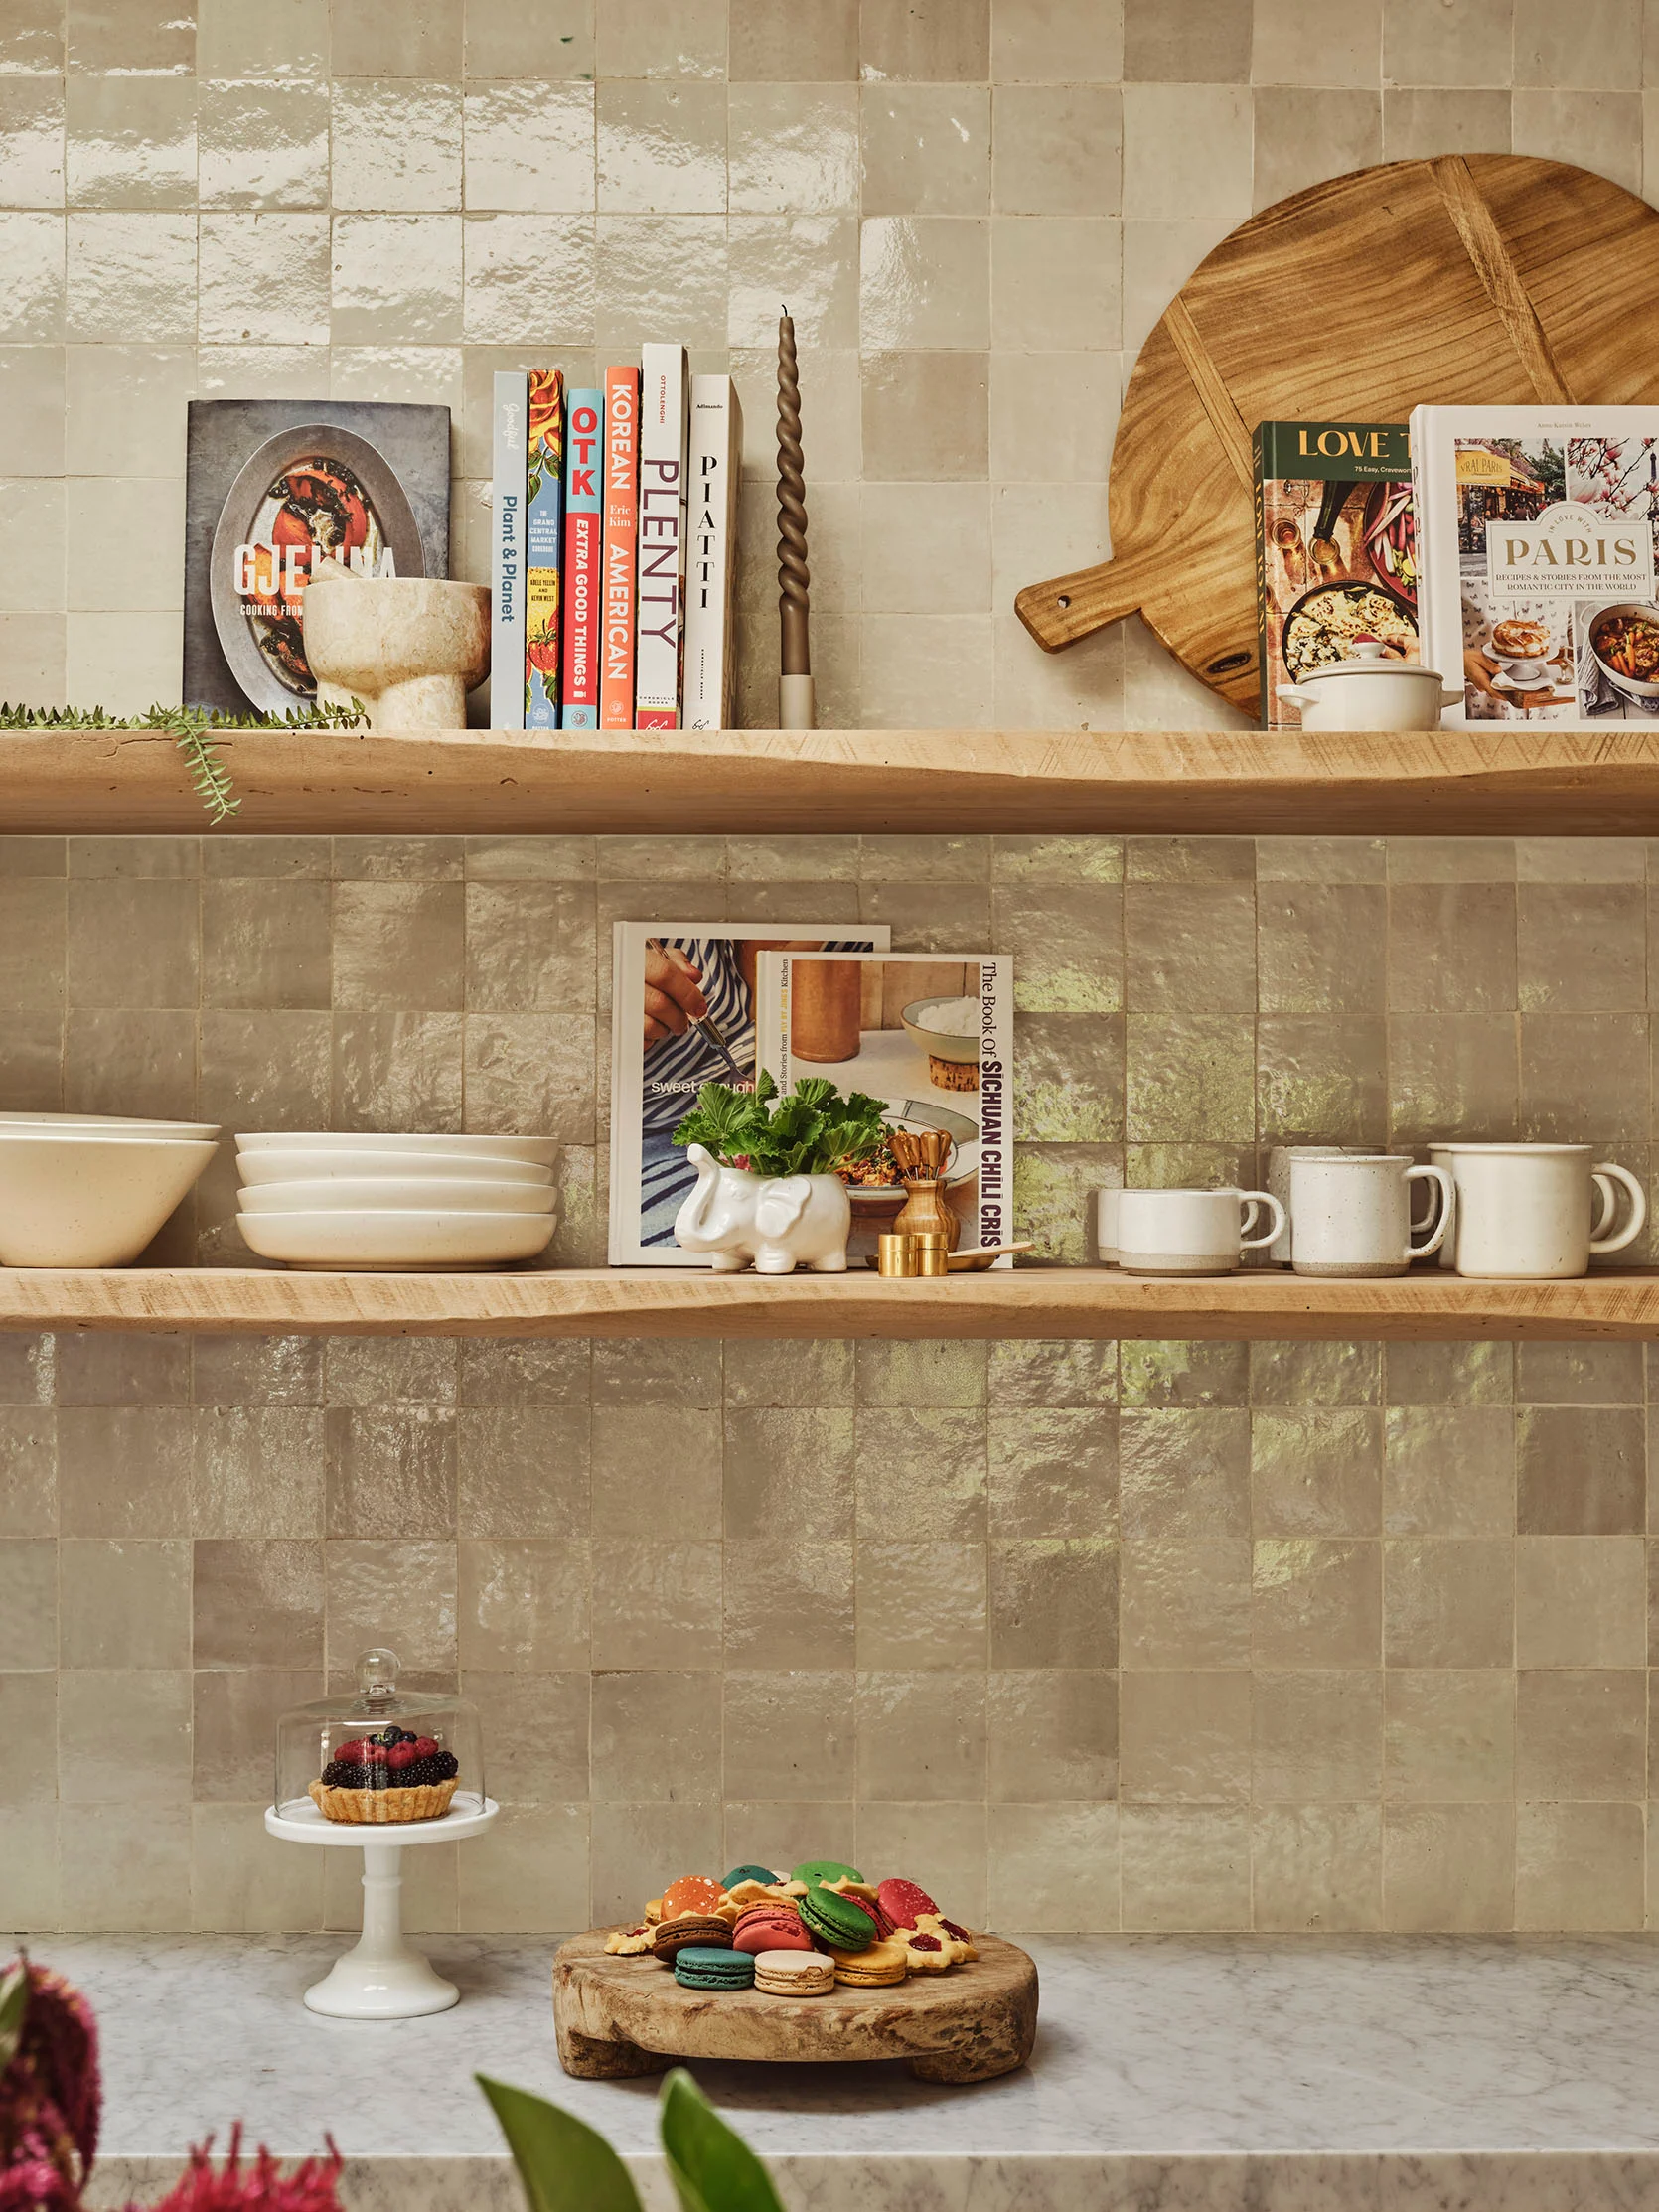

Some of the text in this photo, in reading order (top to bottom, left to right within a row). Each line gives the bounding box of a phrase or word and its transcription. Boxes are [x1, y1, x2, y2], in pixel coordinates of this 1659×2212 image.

[572, 407, 598, 496] OTK
[611, 384, 632, 490] KOREAN
[1299, 430, 1389, 458] LOVE
[609, 516, 631, 527] Kim
[610, 505, 631, 515] Eric
[1554, 515, 1574, 524] LOVE
[696, 456, 717, 608] PIATTI
[501, 496, 517, 622] Plant & Planet
[641, 460, 679, 649] PLENTY
[1505, 539, 1636, 566] PARIS
[239, 604, 278, 616] COOKING
[573, 519, 588, 686] EXTRA GOOD THINGS
[608, 544, 629, 679] AMERICAN
[981, 962, 997, 992] The
[981, 996, 997, 1034] Book
[981, 1038, 997, 1058] Of
[651, 1081, 696, 1094] sweet
